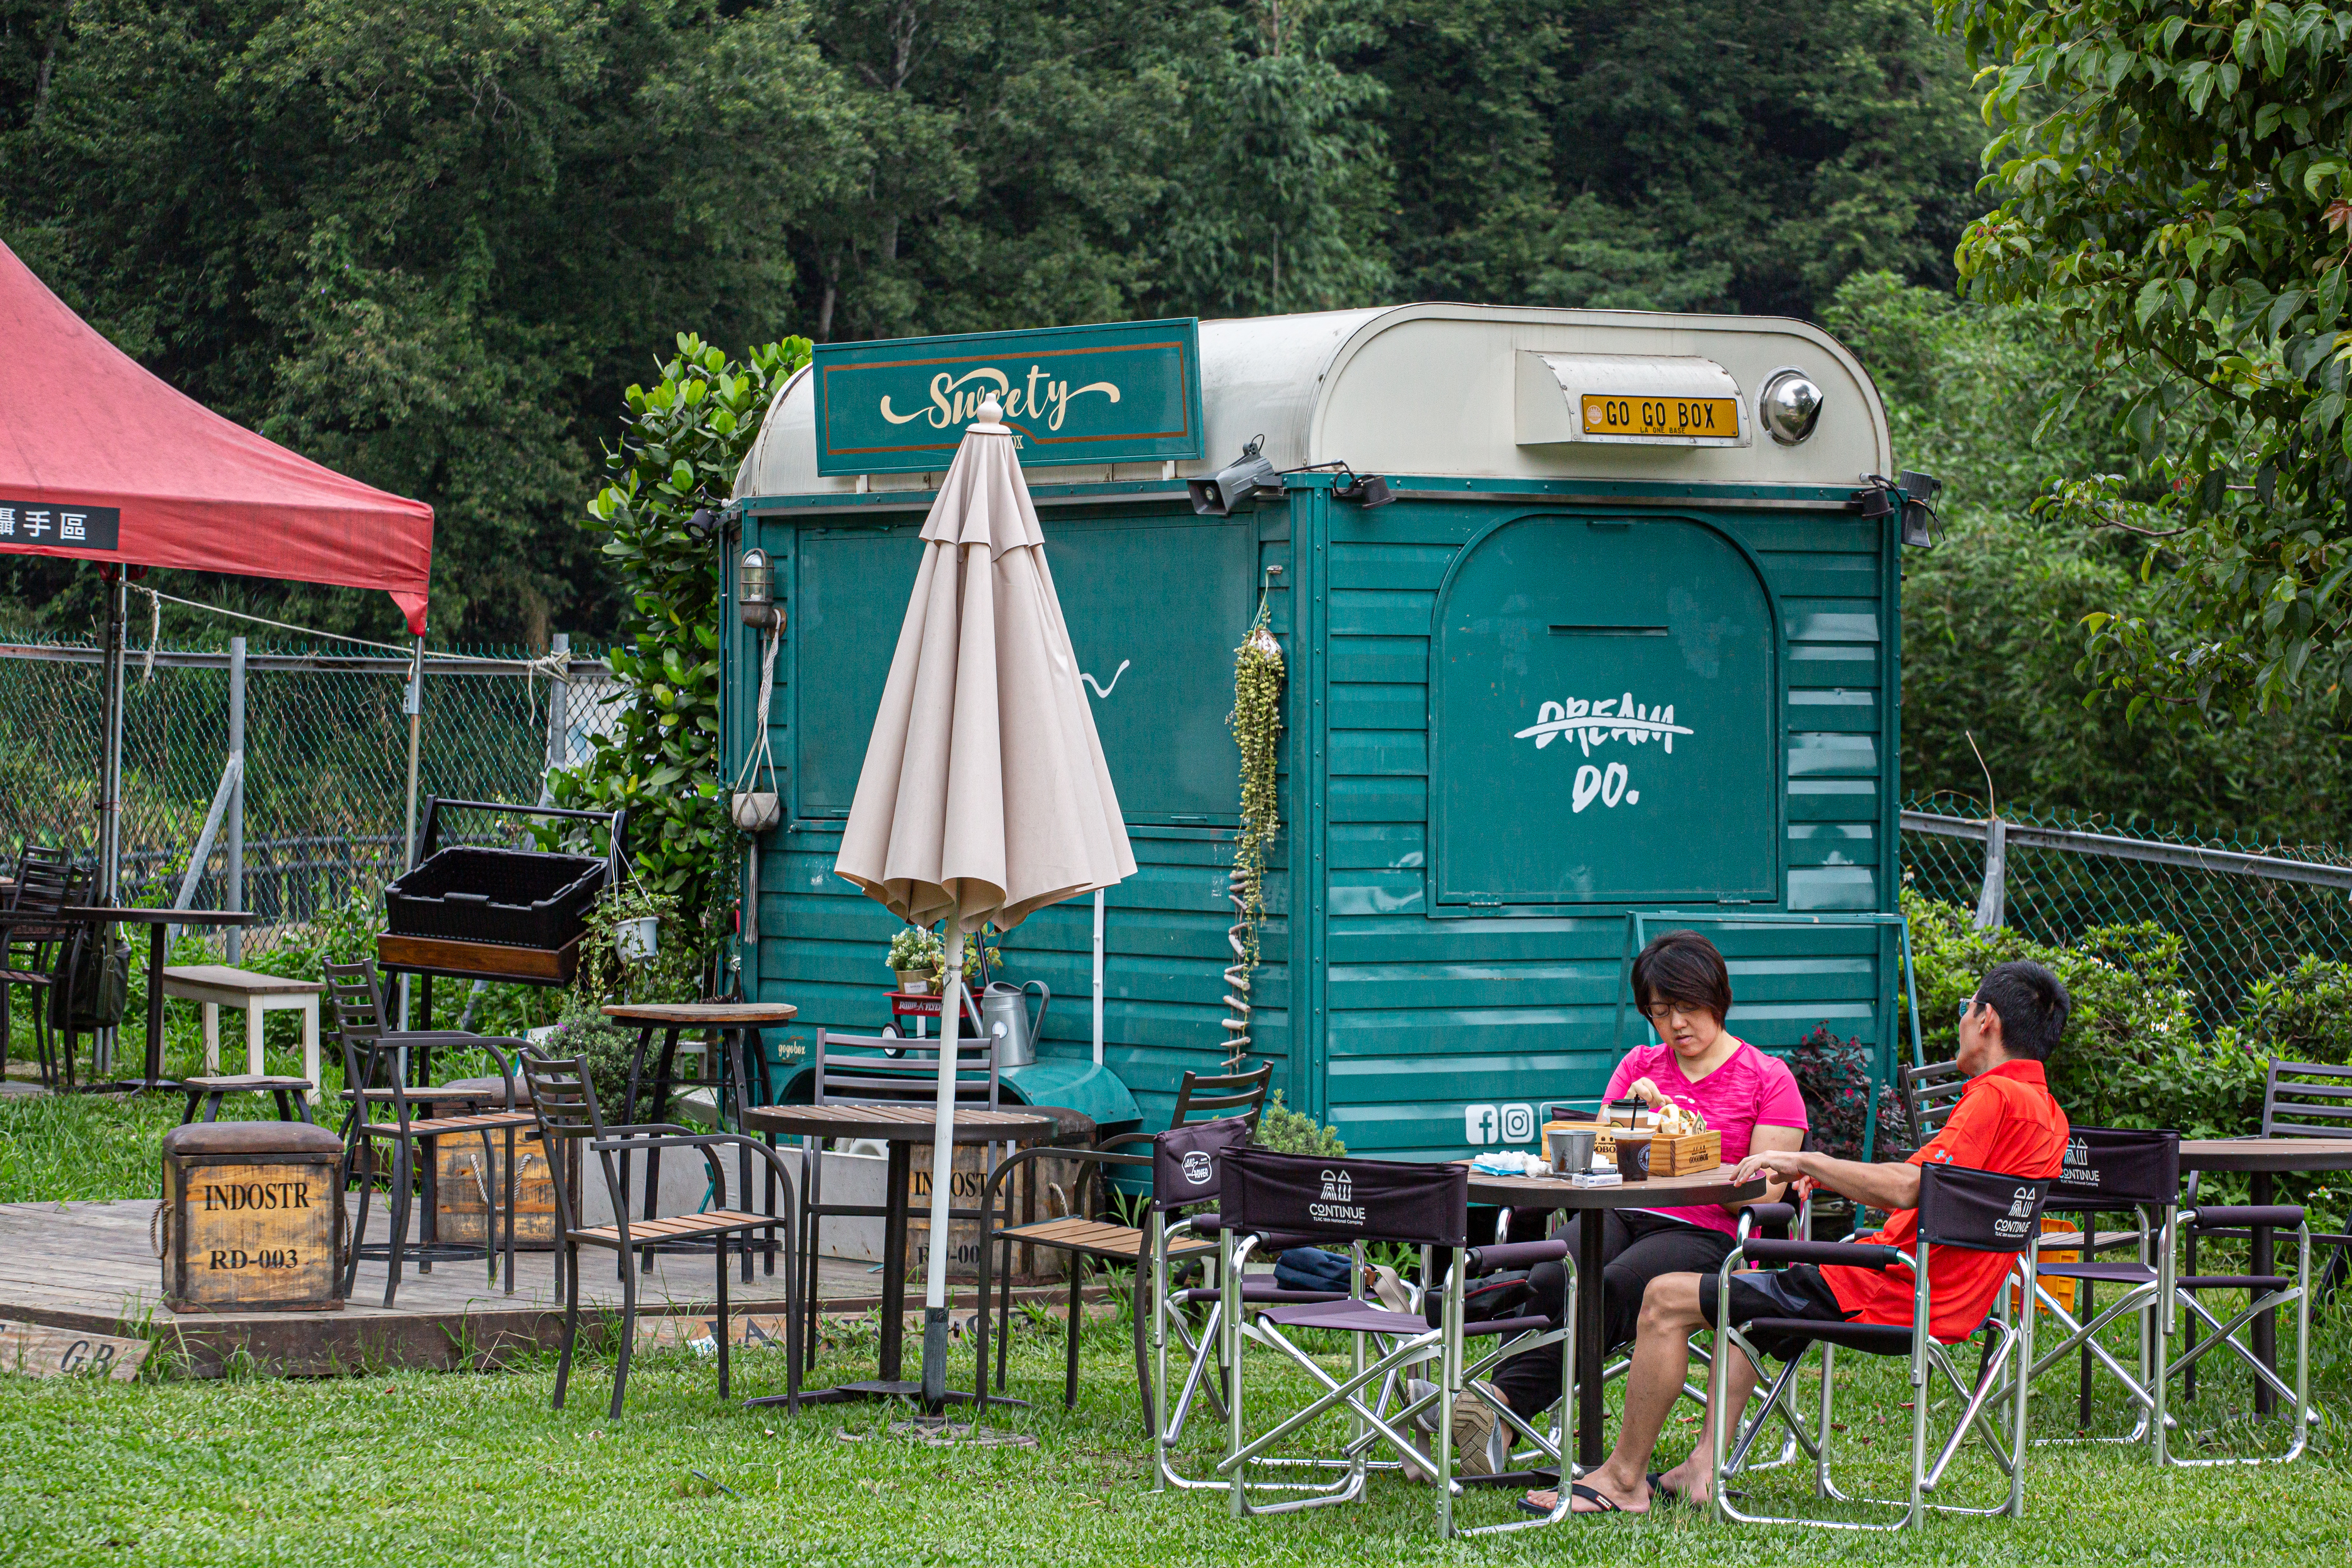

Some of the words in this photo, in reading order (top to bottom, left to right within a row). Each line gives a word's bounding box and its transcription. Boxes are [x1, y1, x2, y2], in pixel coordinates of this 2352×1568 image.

[1606, 401, 1630, 426] GO
[1642, 401, 1665, 427] GO
[1678, 402, 1715, 429] BOX
[1534, 692, 1674, 757] DREAM
[1572, 762, 1639, 813] DO.
[778, 1040, 805, 1058] gogobox
[1185, 1158, 1195, 1168] LAND
[1689, 1153, 1708, 1163] GOGOBOX
[1194, 1168, 1209, 1179] ROVER
[204, 1182, 311, 1211] INDOSTR
[1309, 1203, 1366, 1219] CONTINUE
[1995, 1219, 2031, 1233] CONTINUE
[209, 1249, 298, 1270] RD-003
